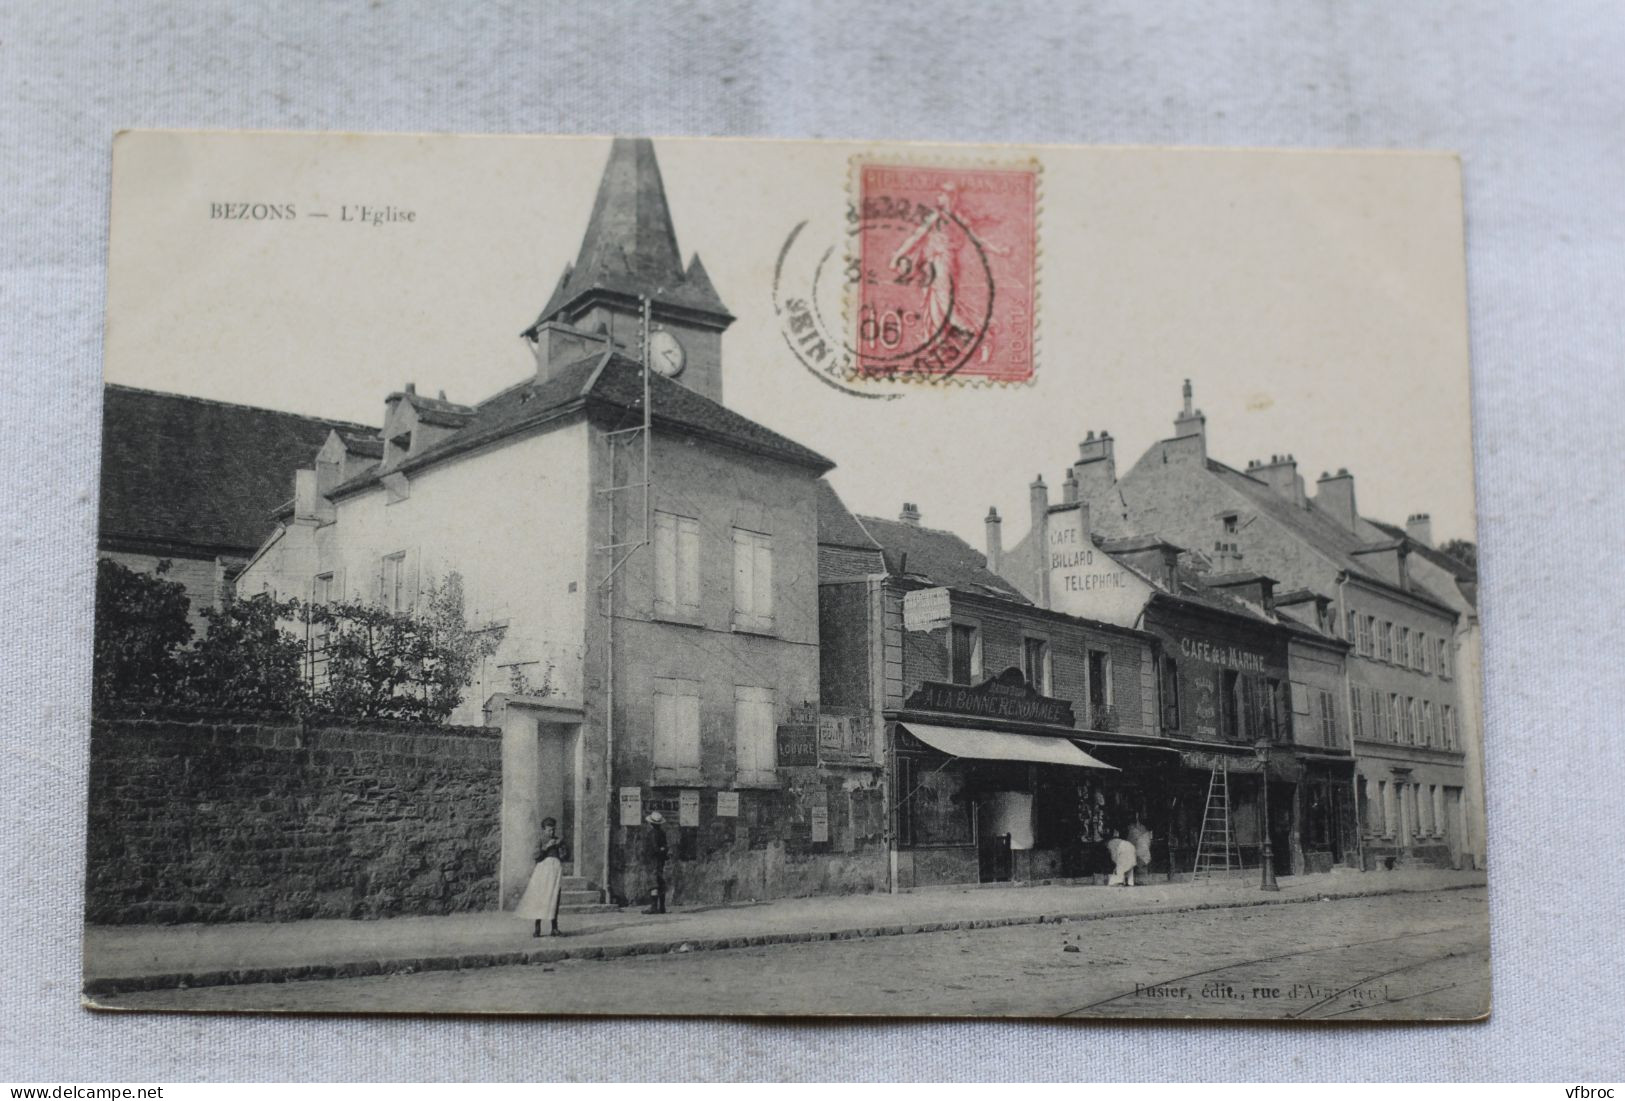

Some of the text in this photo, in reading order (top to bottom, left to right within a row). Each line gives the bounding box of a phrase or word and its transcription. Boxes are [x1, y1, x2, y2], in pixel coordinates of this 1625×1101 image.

[210, 202, 298, 221] BEZONS
[341, 204, 417, 227] L'Eglise
[1052, 550, 1093, 569] BILLARD
[1181, 637, 1210, 662] CAFÉ
[1228, 646, 1265, 672] MARINE
[936, 689, 953, 708] LA
[957, 690, 996, 714] BONNE
[779, 743, 815, 755] LOUVRE
[1252, 987, 1280, 999] rue
